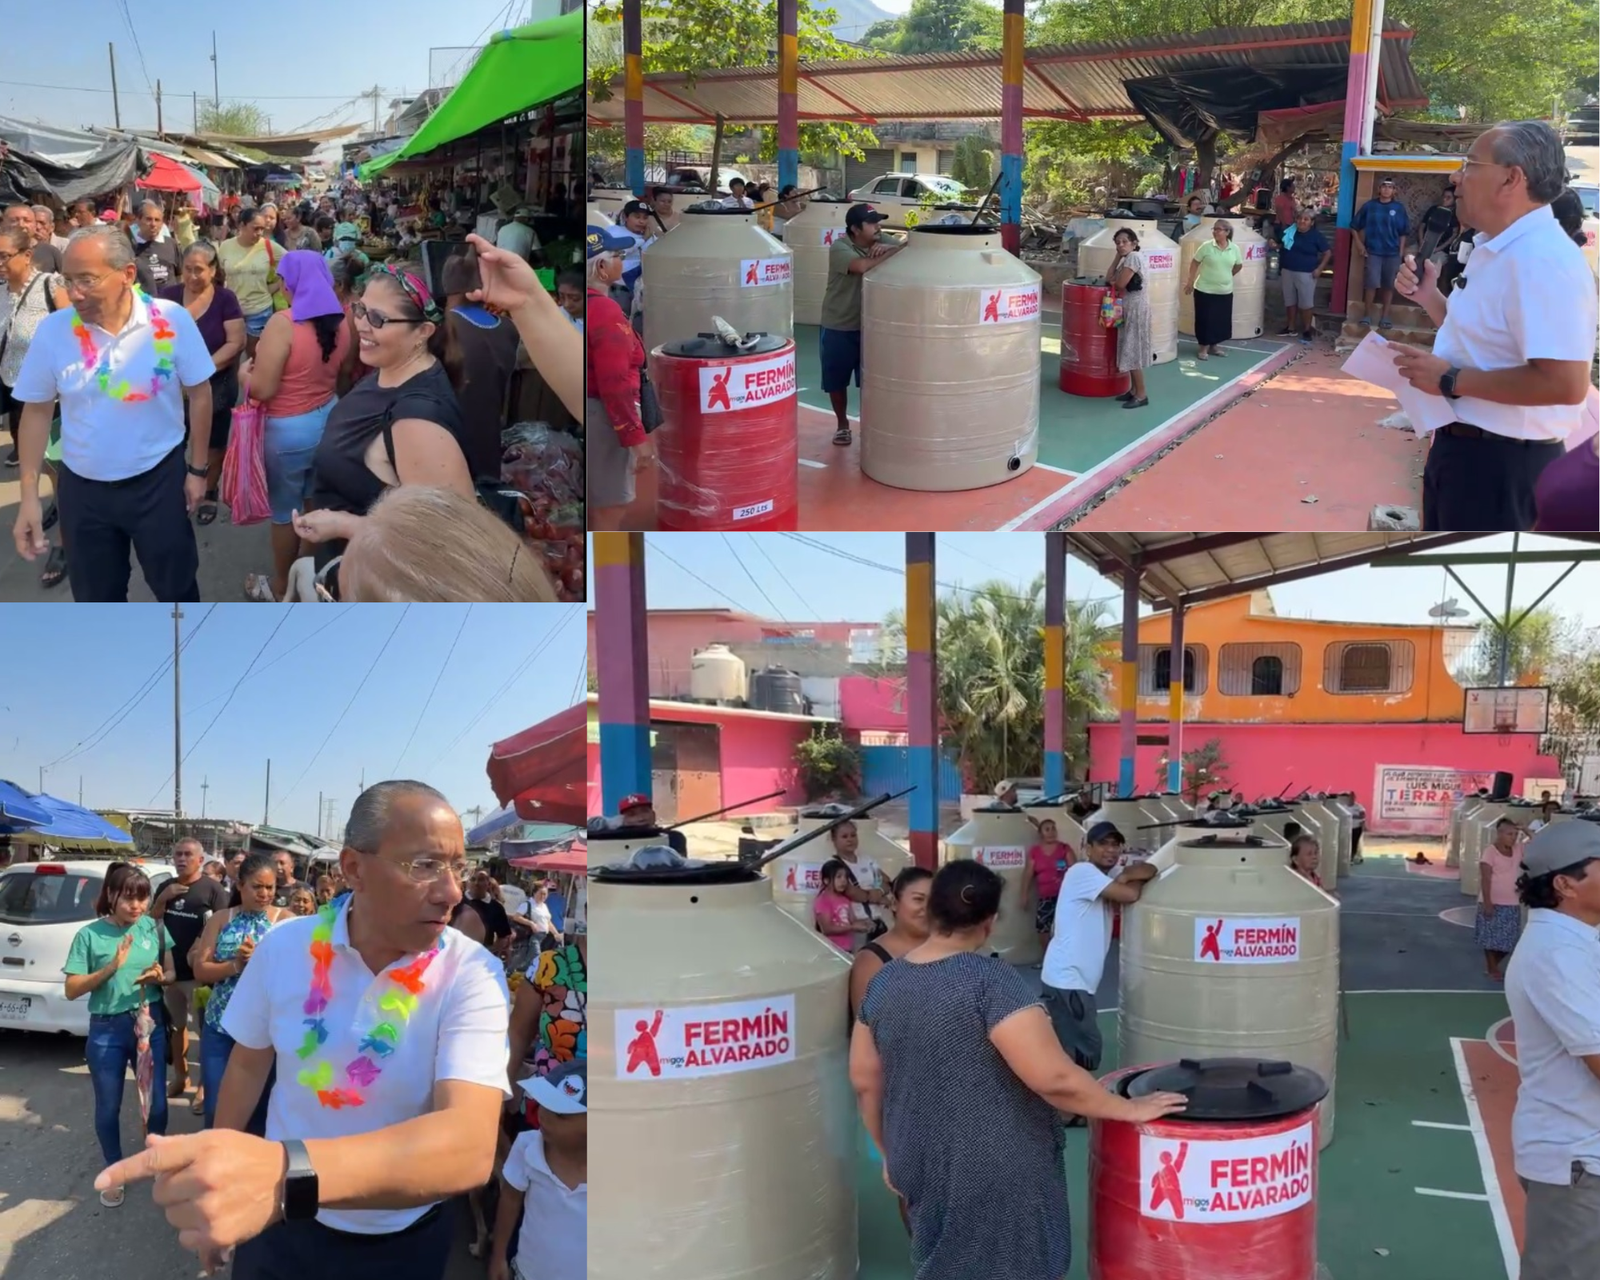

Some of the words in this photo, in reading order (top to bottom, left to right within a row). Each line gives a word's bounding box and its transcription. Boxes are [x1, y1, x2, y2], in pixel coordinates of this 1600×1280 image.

[1009, 289, 1038, 307] FERMÍN
[745, 360, 795, 389] FERMÍN
[745, 378, 795, 402] ALVARADO
[740, 507, 755, 517] 250
[990, 848, 1022, 859] FERMÍN
[1235, 924, 1296, 944] FERMÍN
[1234, 945, 1297, 957] ALVARADO
[685, 1007, 788, 1047] FERMÍN
[685, 1037, 790, 1067] ALVARADO
[1211, 1140, 1309, 1188] FERMÍN
[1210, 1174, 1309, 1211] ALVARADO
